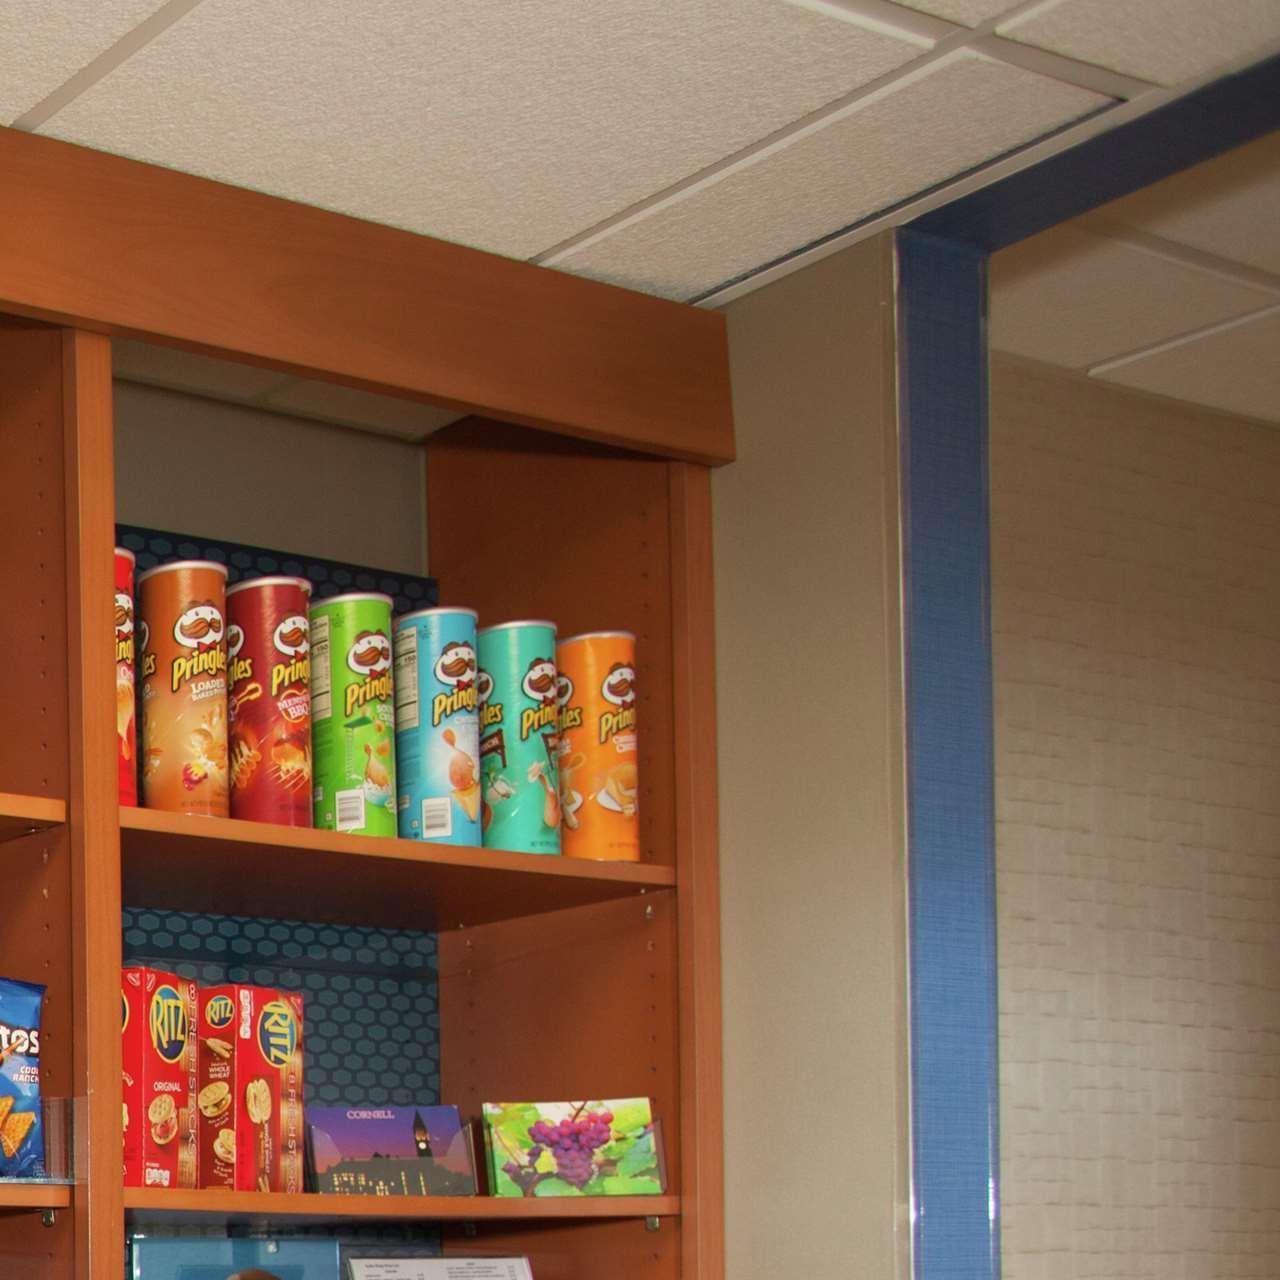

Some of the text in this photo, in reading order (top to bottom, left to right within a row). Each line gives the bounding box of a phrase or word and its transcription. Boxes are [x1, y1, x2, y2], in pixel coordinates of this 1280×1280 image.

[152, 995, 187, 1050] RITZ
[206, 1000, 233, 1026] RITZ
[263, 1002, 290, 1068] RITZ
[346, 1110, 395, 1120] CORNELL
